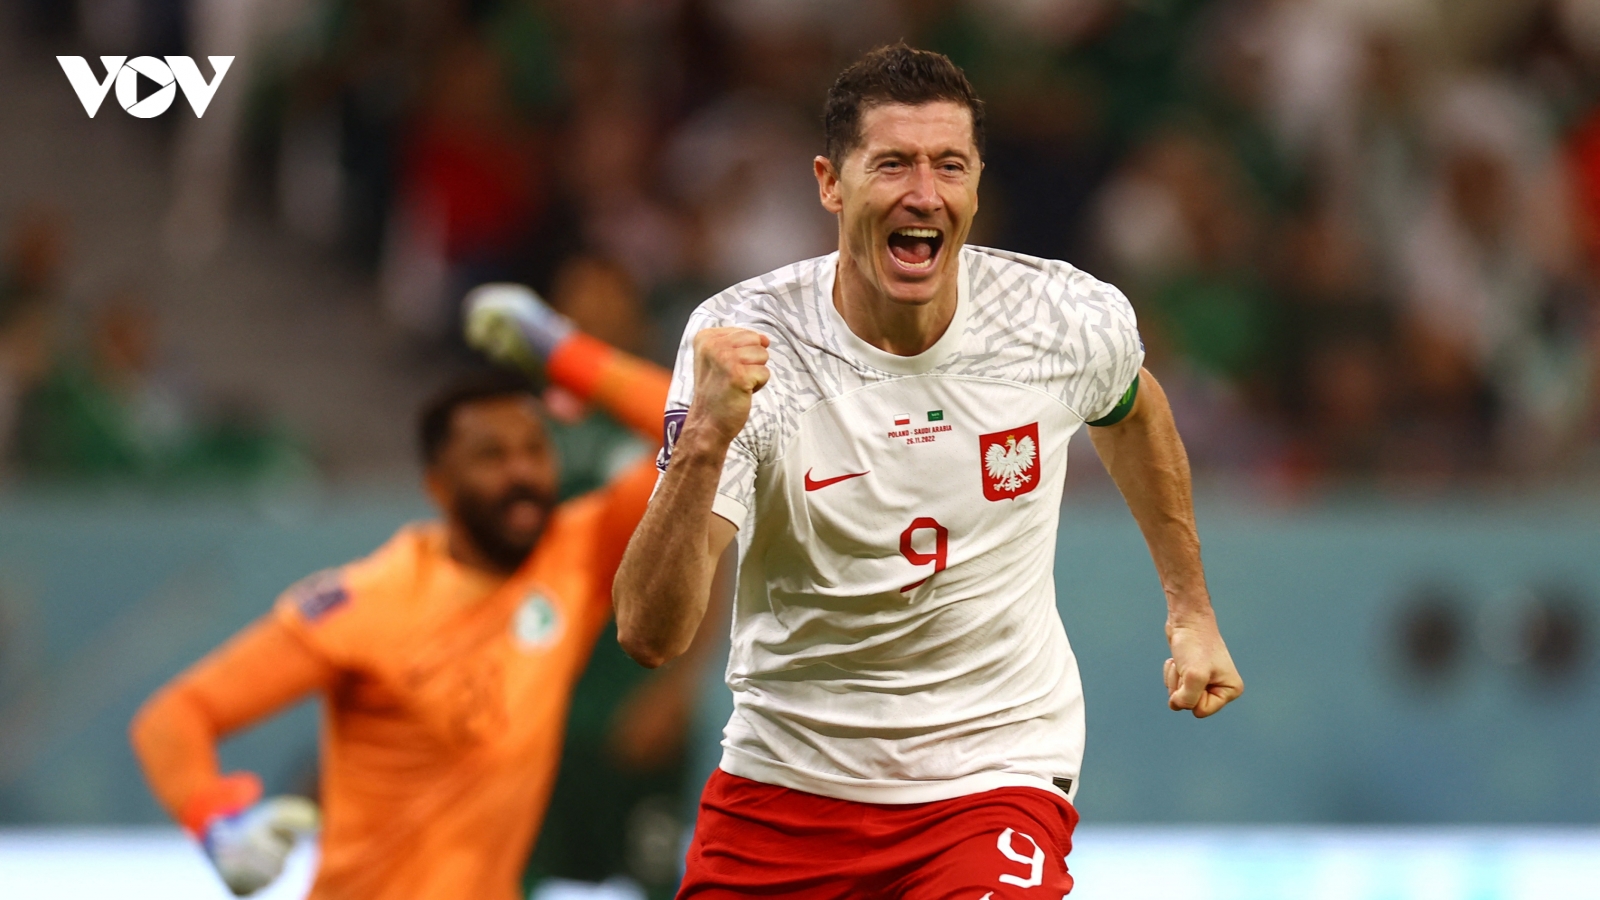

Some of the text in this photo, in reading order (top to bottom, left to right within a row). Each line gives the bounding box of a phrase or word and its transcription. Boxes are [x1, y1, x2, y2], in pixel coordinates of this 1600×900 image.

[888, 430, 909, 438] POLAND
[914, 427, 931, 435] SAUDI
[932, 425, 952, 433] ARABIA
[906, 435, 935, 444] 26.11.2022
[900, 517, 948, 592] 9
[996, 827, 1045, 888] 9
